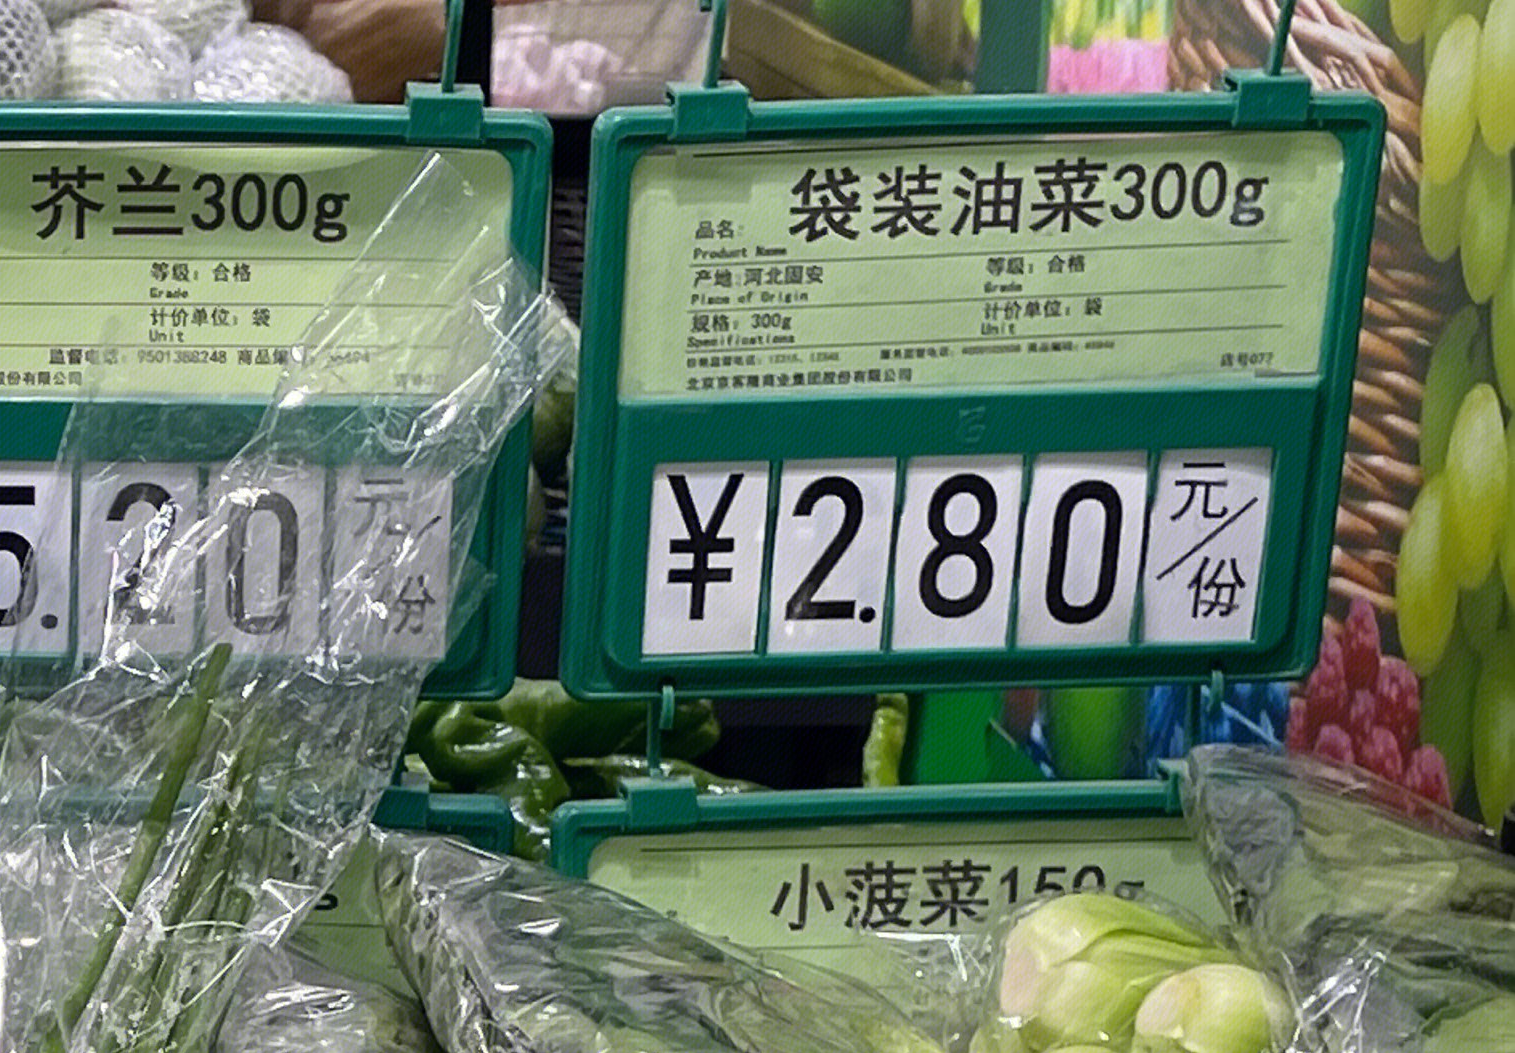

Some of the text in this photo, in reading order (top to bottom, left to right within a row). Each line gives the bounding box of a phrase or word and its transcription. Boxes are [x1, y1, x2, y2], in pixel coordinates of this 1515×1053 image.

[31, 164, 351, 243] 芥兰300g
[788, 157, 1269, 242] 袋装油菜300g
[148, 329, 185, 343] Unit
[981, 321, 1017, 337] Unit
